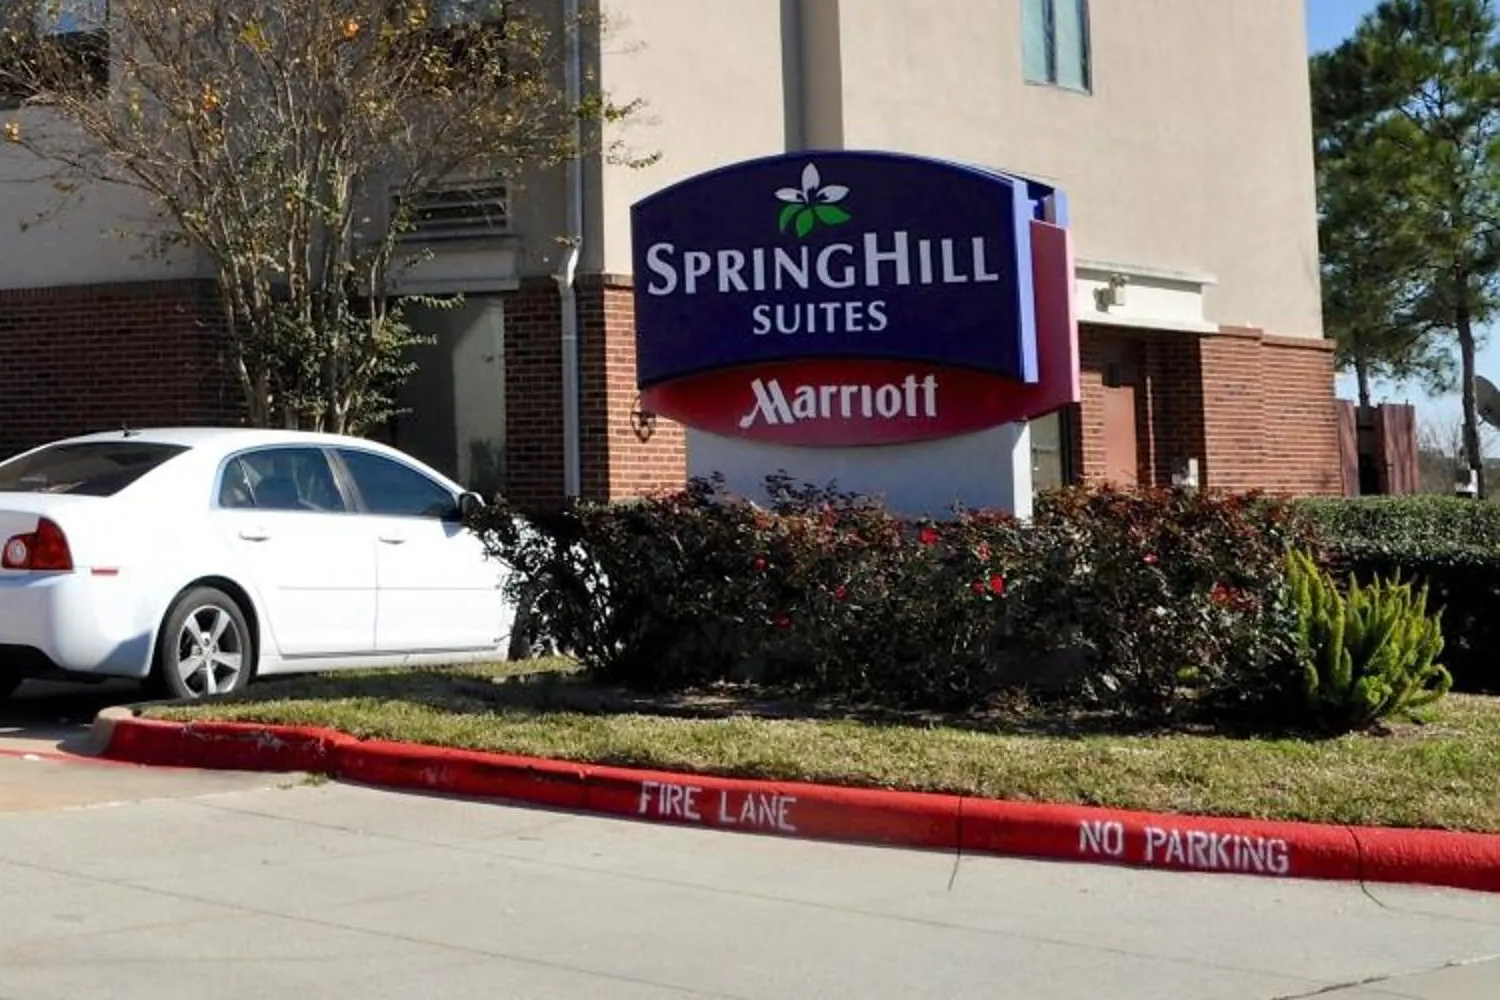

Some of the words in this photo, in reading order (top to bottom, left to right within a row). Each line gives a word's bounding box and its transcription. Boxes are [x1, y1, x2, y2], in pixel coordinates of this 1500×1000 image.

[646, 230, 1000, 296] SPRINGHILL
[752, 301, 889, 335] SUITES
[739, 374, 939, 429] Marriott
[638, 780, 702, 820] FIRE
[719, 789, 798, 832] LANE
[1079, 820, 1124, 855] NO
[1144, 826, 1289, 874] PARKING
